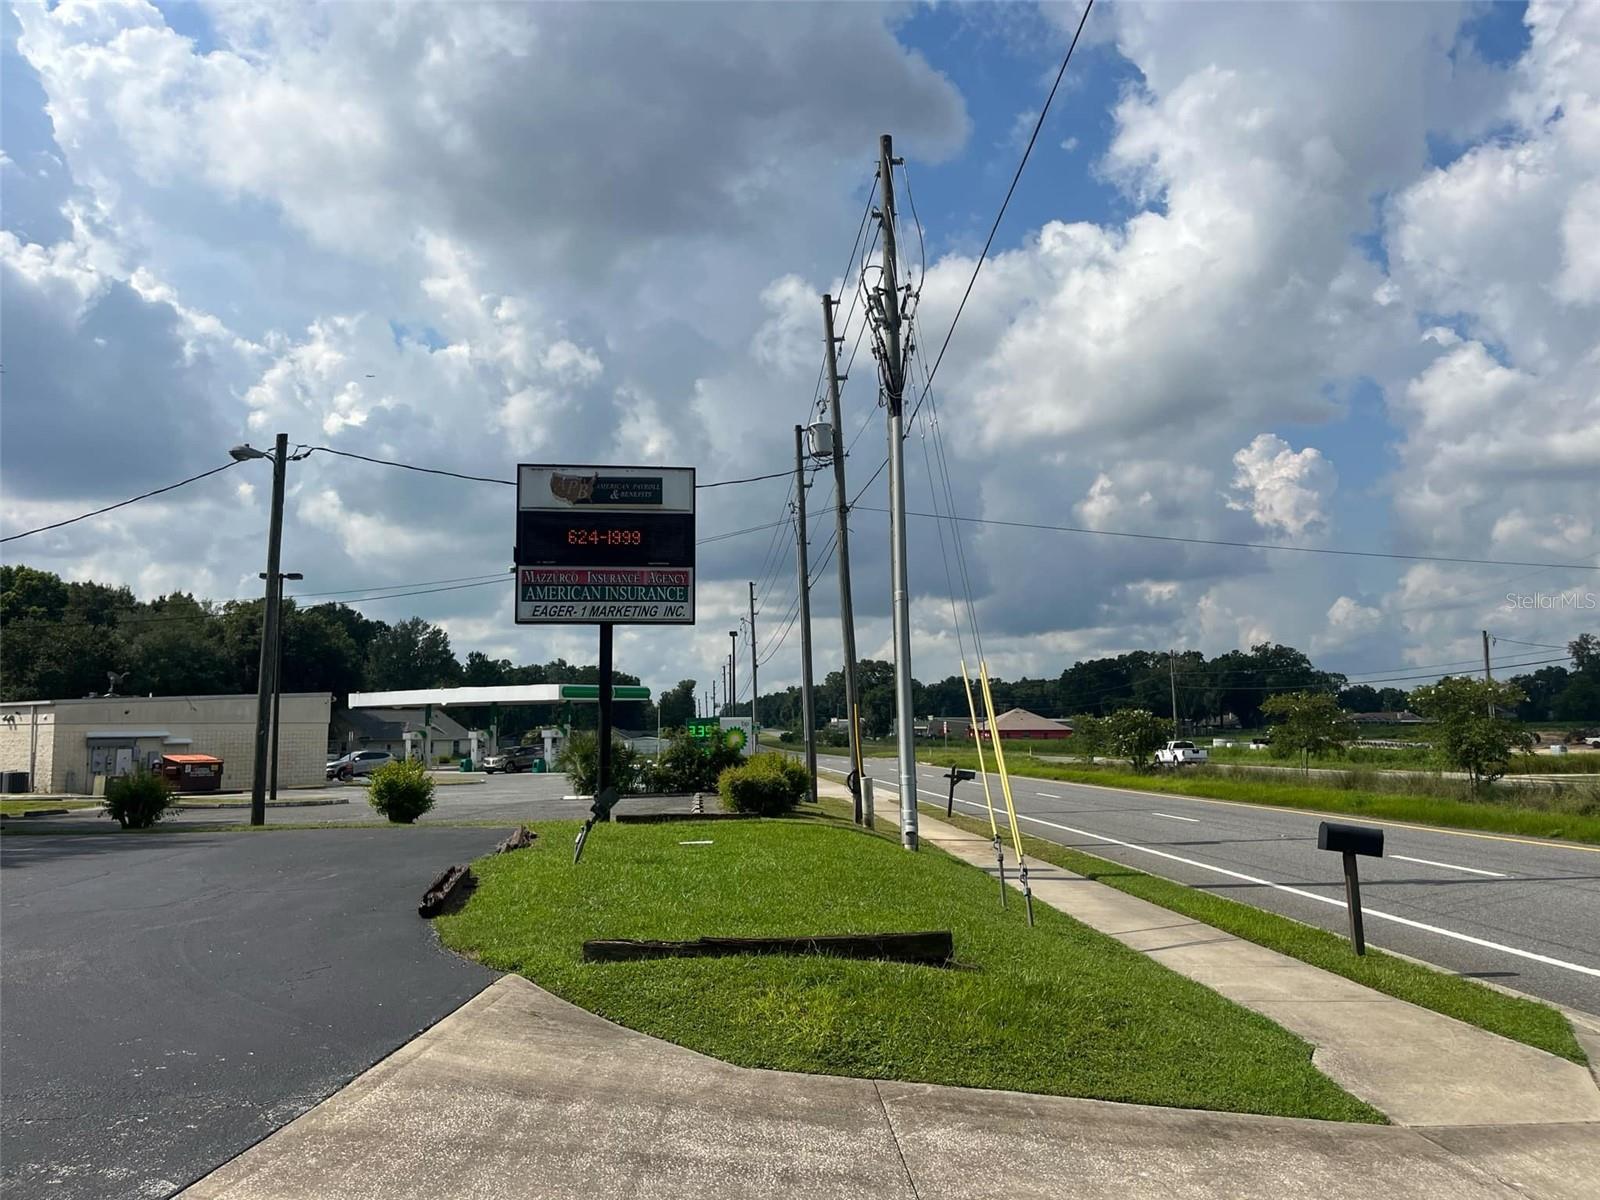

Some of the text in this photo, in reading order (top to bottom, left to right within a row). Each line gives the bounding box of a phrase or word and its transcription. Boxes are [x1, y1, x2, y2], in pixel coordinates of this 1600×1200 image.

[610, 490, 620, 499] &
[568, 529, 641, 544] 624-1999
[524, 570, 687, 583] MAZZURCO INSURANCE AGENCY
[526, 586, 685, 601] AMERICAN INSURANCE
[588, 605, 658, 617] MARKETING
[663, 605, 686, 617] INC.
